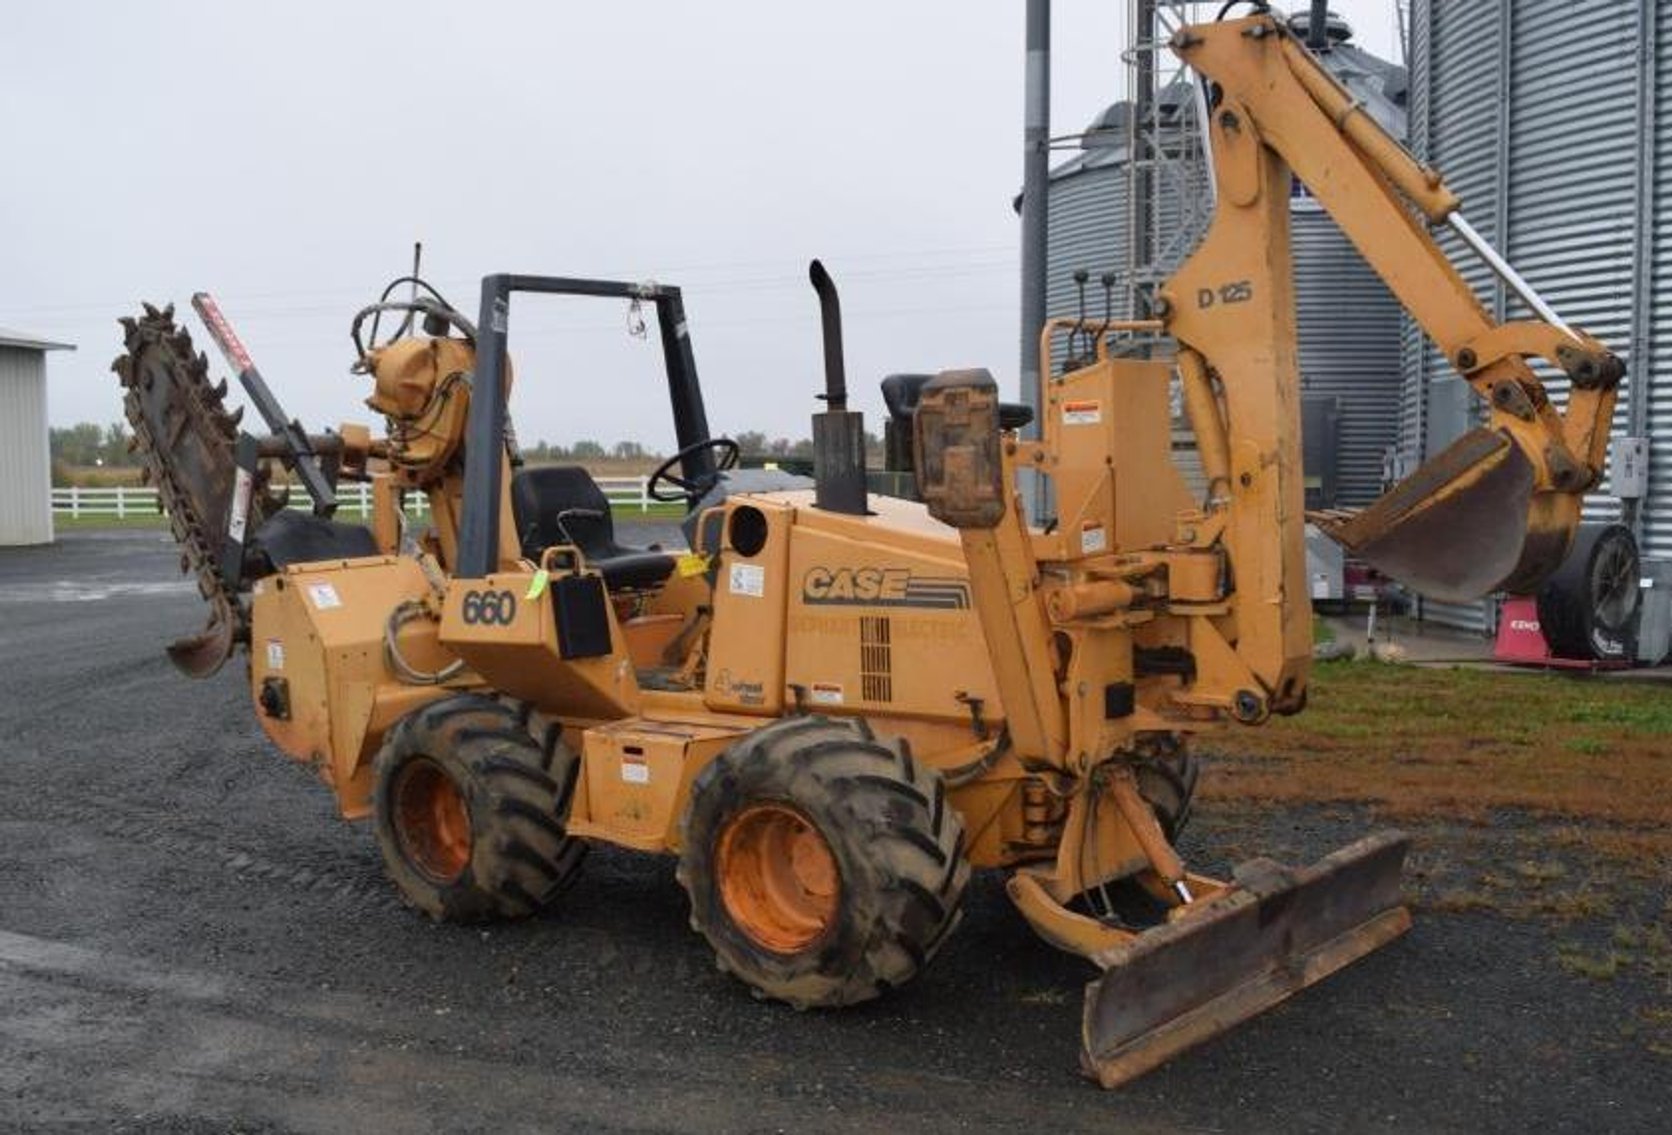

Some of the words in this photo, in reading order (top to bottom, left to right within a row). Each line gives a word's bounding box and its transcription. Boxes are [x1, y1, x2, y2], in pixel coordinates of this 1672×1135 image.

[1198, 288, 1214, 309] D
[1218, 280, 1253, 304] 125
[803, 566, 910, 600] CASE
[462, 590, 516, 625] 660
